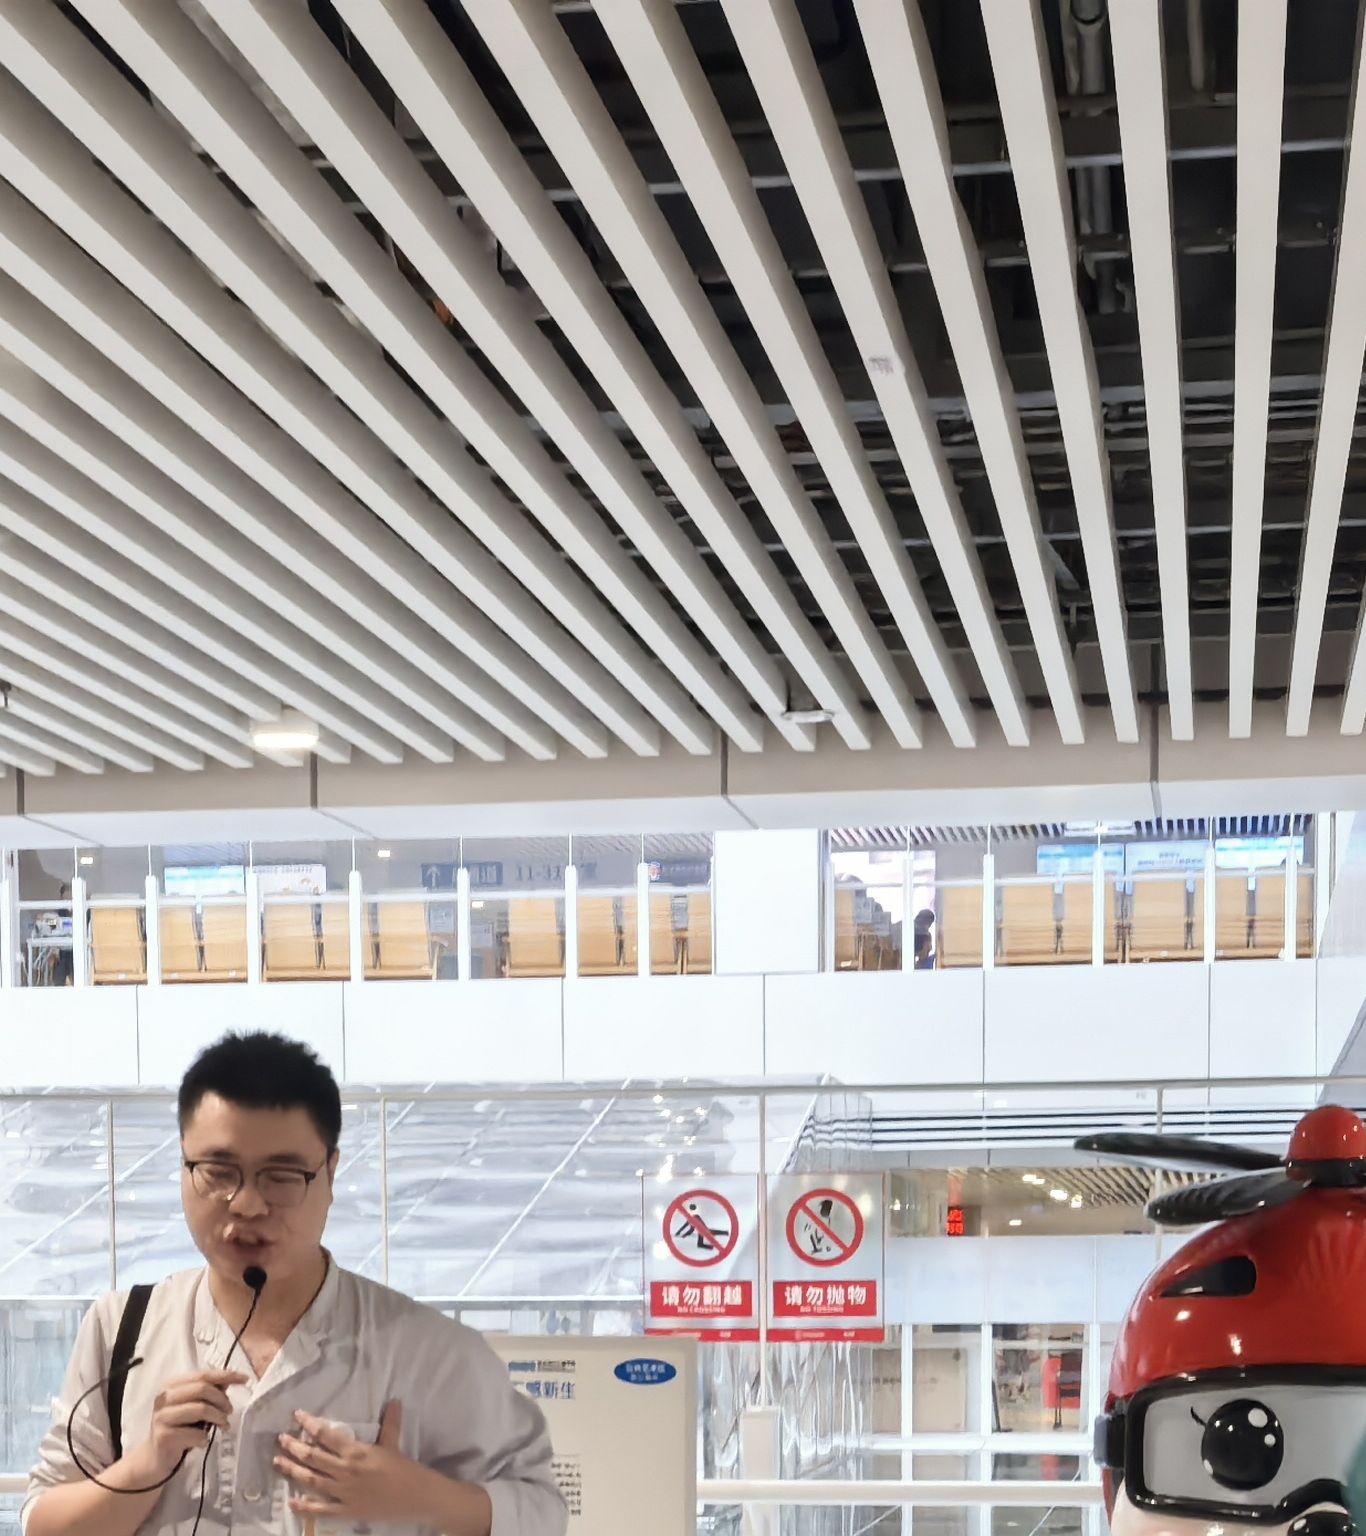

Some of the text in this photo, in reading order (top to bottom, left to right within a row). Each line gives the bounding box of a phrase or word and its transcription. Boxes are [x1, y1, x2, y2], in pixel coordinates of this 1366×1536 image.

[662, 1284, 742, 1306] 请勿翻越
[785, 1284, 867, 1306] 请勿抛物
